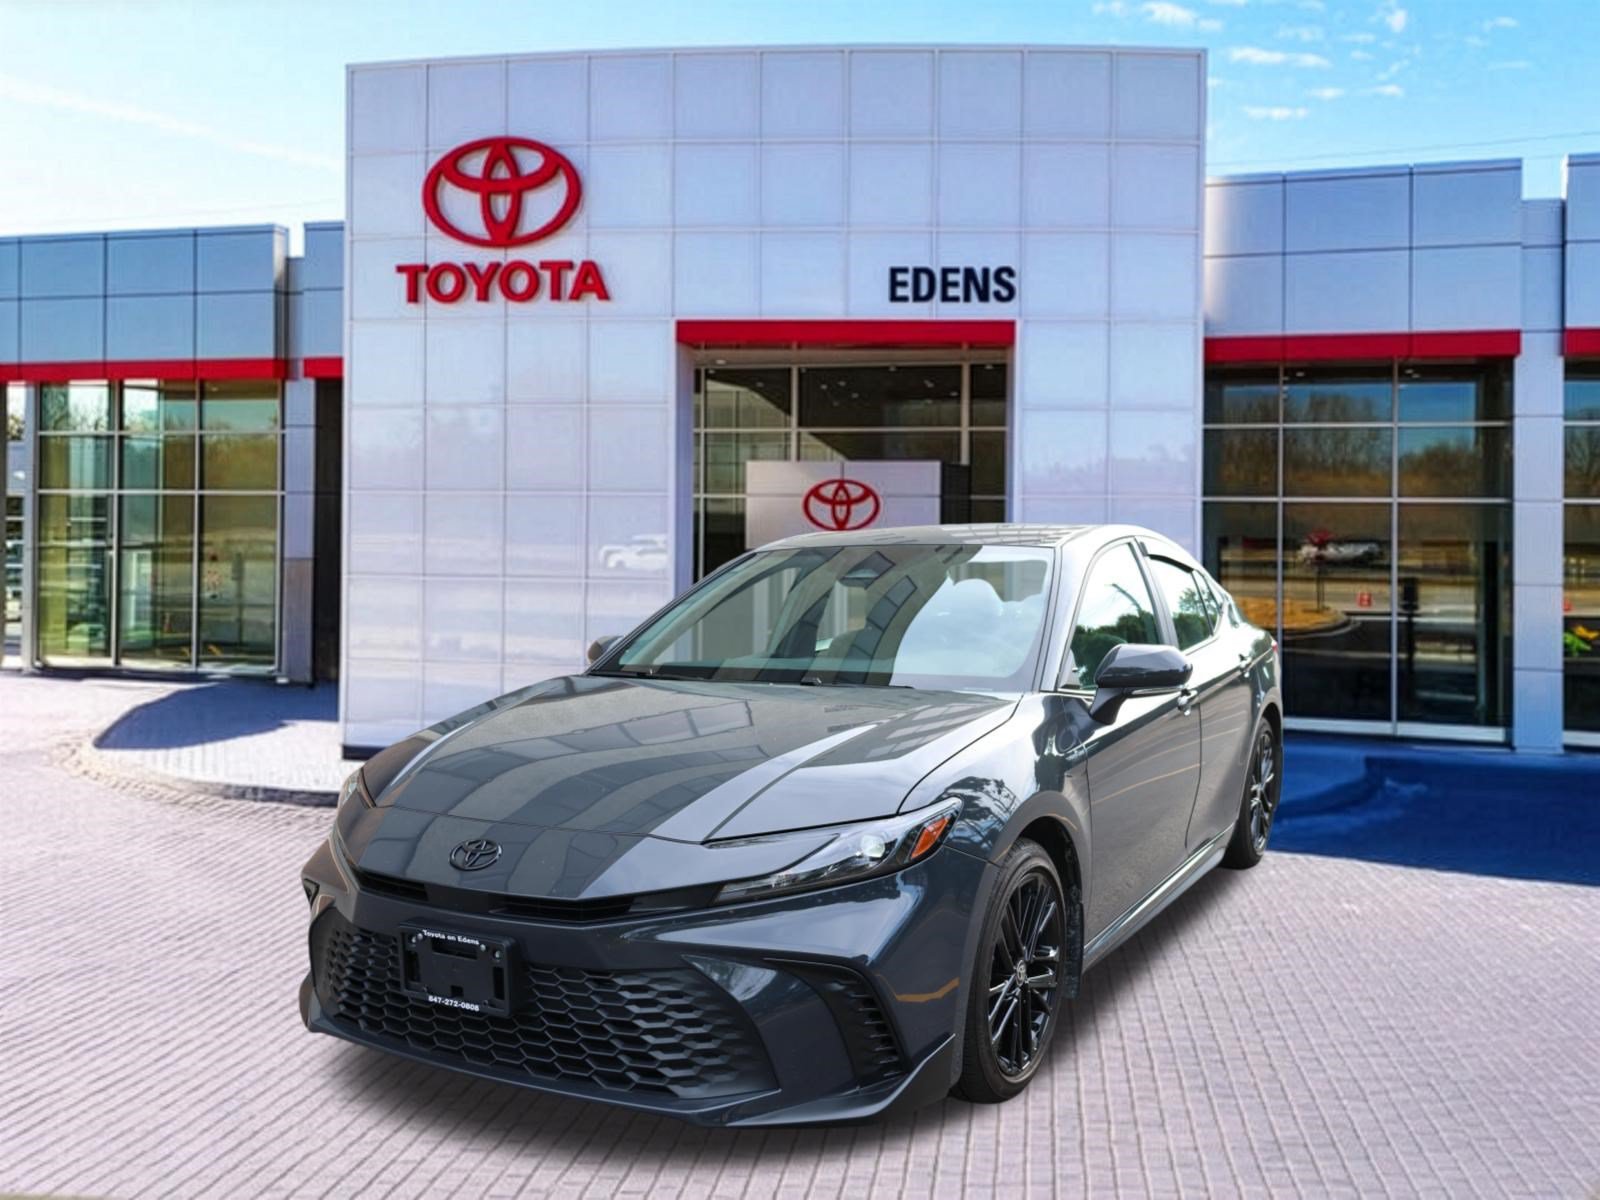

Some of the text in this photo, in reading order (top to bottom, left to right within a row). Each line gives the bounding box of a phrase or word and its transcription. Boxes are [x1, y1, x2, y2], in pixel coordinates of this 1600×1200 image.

[395, 260, 610, 304] TOYOTA
[888, 265, 1017, 303] EDENS
[422, 929, 446, 940] Toyota
[457, 935, 480, 945] Edens
